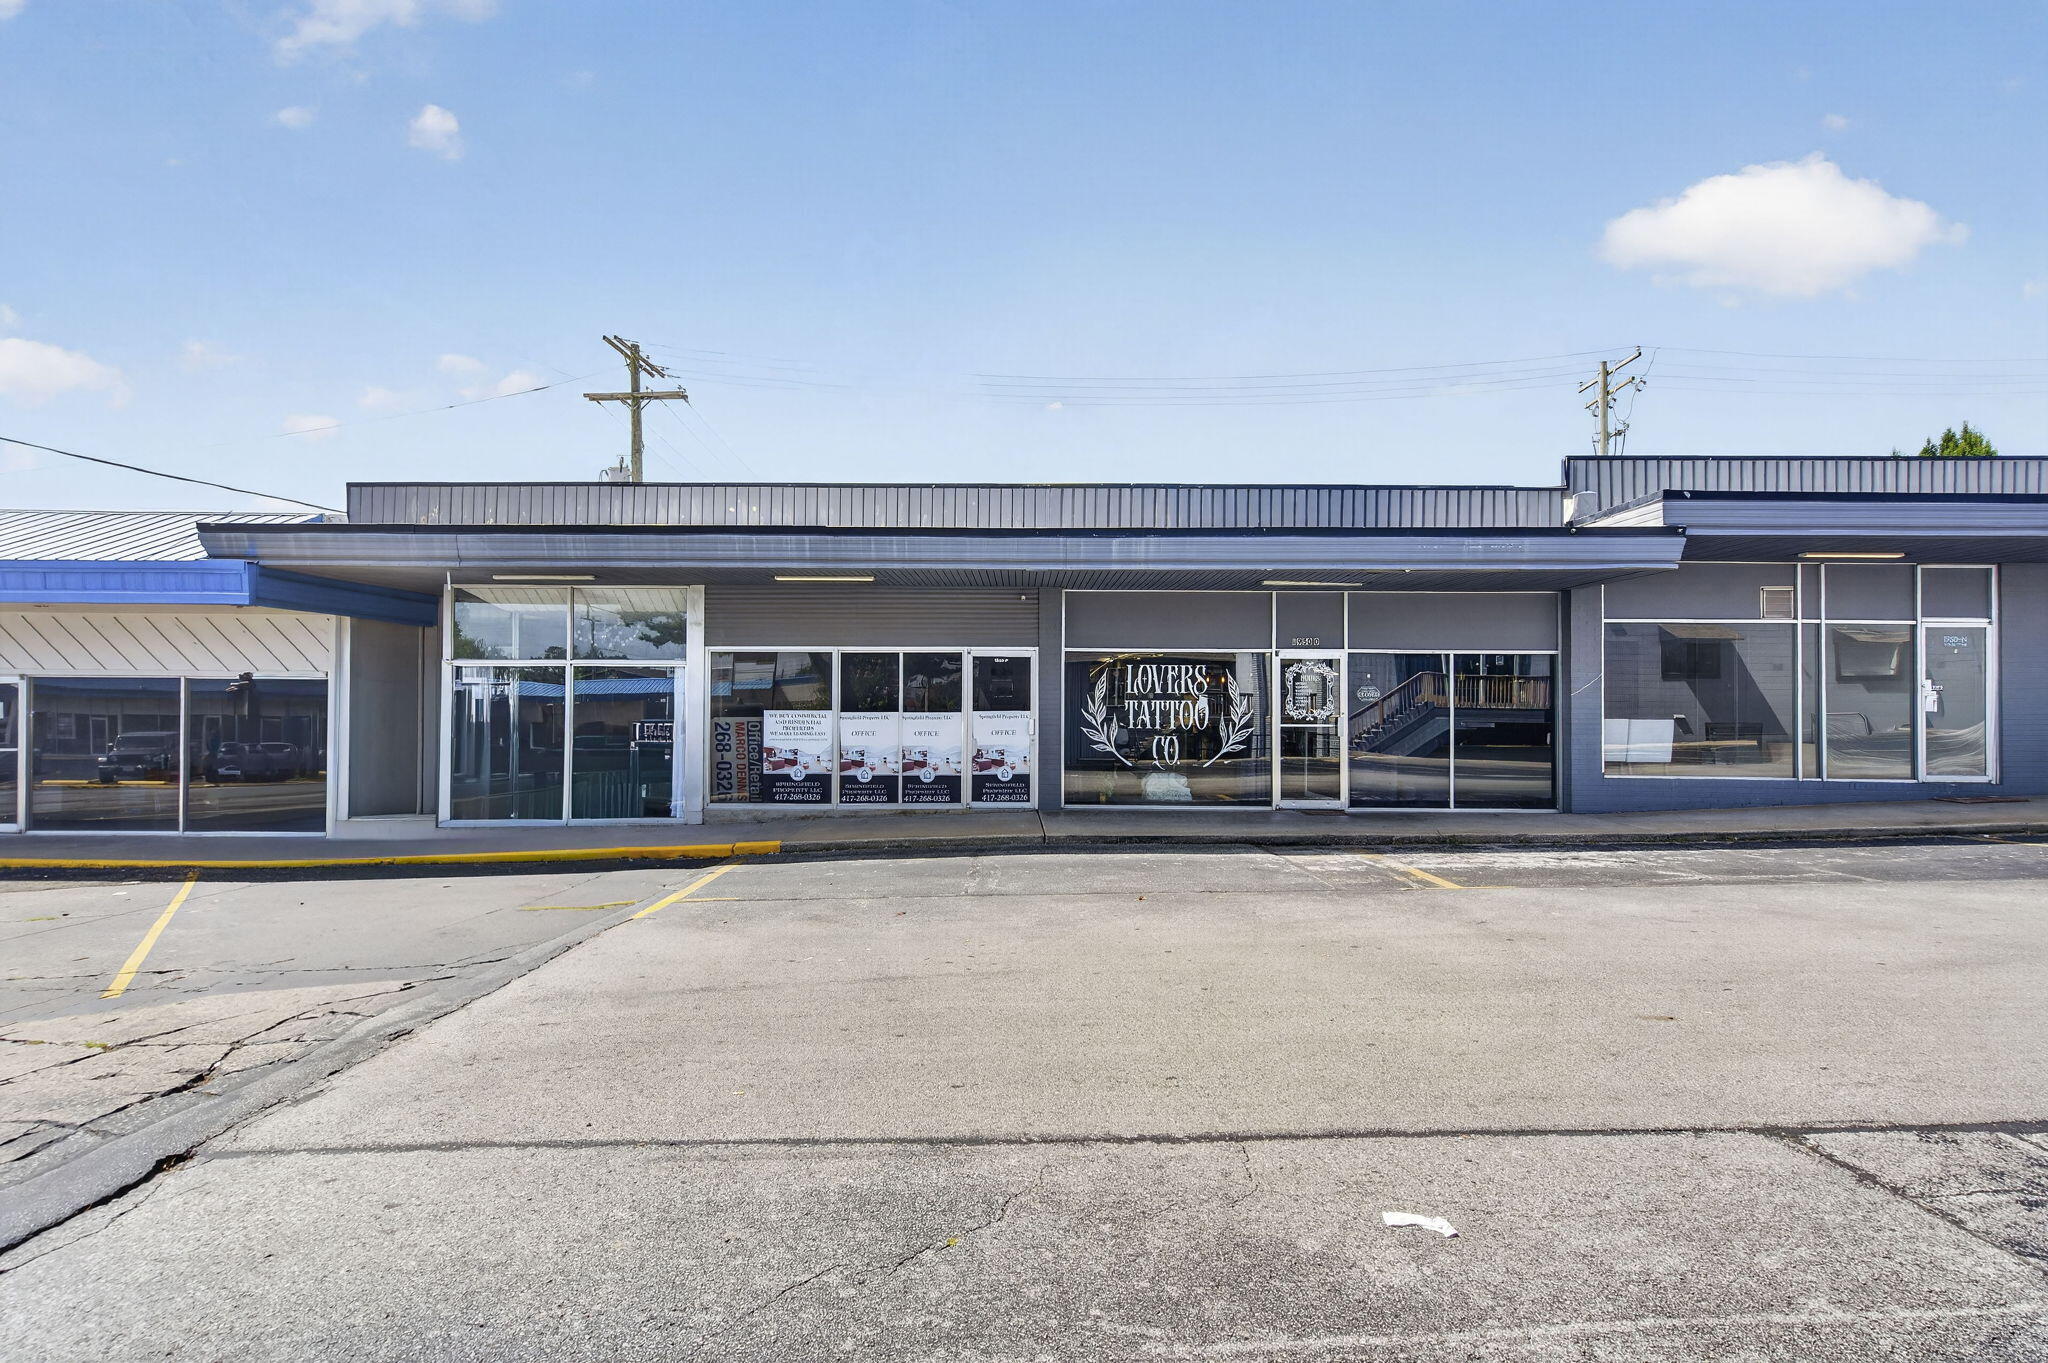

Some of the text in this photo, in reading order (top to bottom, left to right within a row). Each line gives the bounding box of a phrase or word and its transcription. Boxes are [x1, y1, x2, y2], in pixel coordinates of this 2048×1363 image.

[1126, 664, 1208, 698] LOVERS
[1124, 700, 1209, 731] TATTOO
[735, 721, 747, 801] MARCO DENNIS
